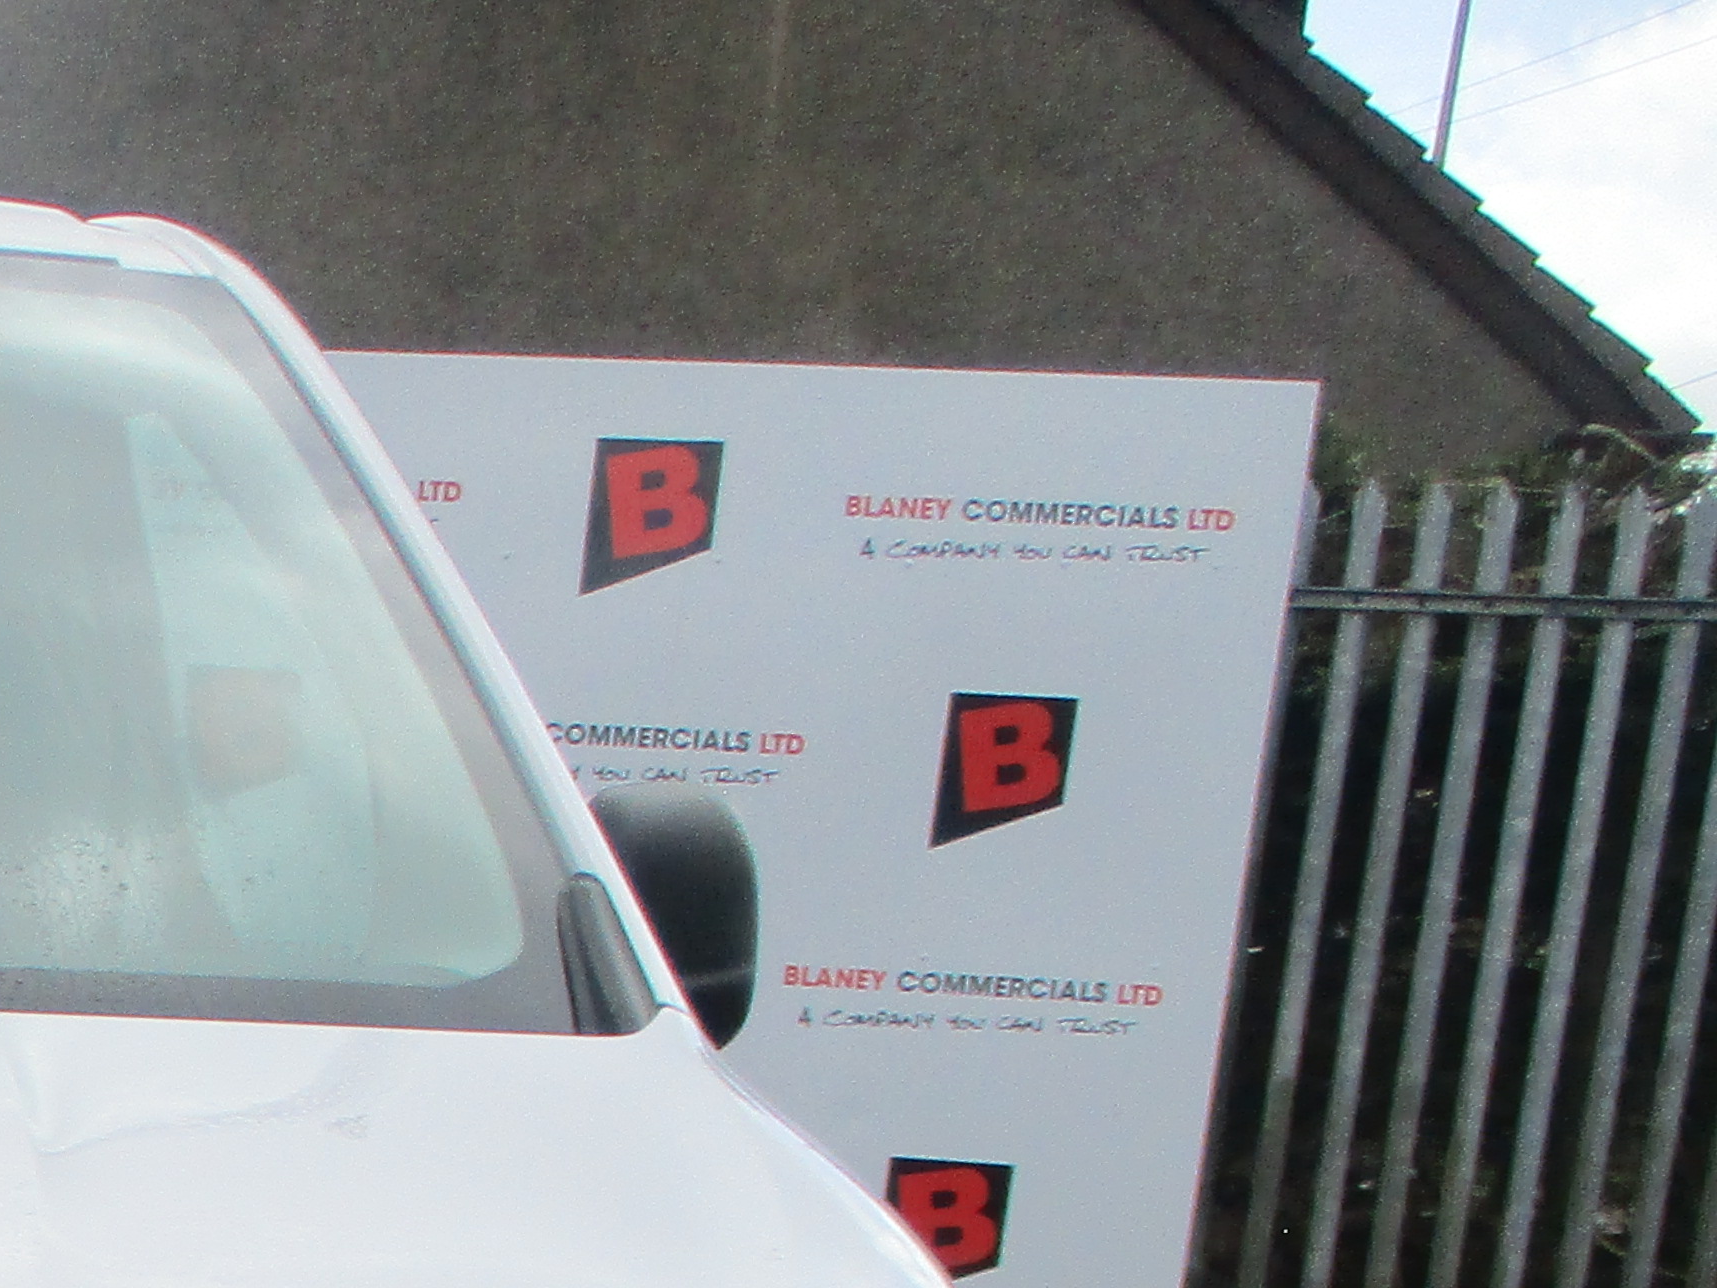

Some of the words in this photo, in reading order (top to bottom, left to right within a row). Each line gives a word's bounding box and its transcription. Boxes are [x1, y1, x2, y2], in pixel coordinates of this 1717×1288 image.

[418, 480, 461, 502] LTD
[608, 445, 708, 560] B
[844, 495, 952, 520] BLANEY
[964, 500, 1179, 529] COMMERCIALS
[1187, 509, 1235, 532] LTD
[859, 538, 875, 559] A
[886, 540, 1002, 560] COMPANY
[1015, 543, 1052, 560] YOU
[1064, 544, 1112, 562] CAN
[1126, 545, 1209, 563] TRUST
[759, 733, 806, 755] LTD
[961, 703, 1061, 813] B
[642, 766, 688, 783] CAN
[701, 765, 779, 785] TRUST
[782, 965, 888, 991] BLANEY
[897, 971, 1110, 1003] COMMERCIALS
[1117, 984, 1165, 1006] LTD
[796, 1006, 814, 1028] A
[822, 1010, 935, 1030] COMPANY
[995, 1015, 1045, 1032] CAN
[1056, 1017, 1139, 1036] TRUST
[899, 1168, 996, 1268] B
